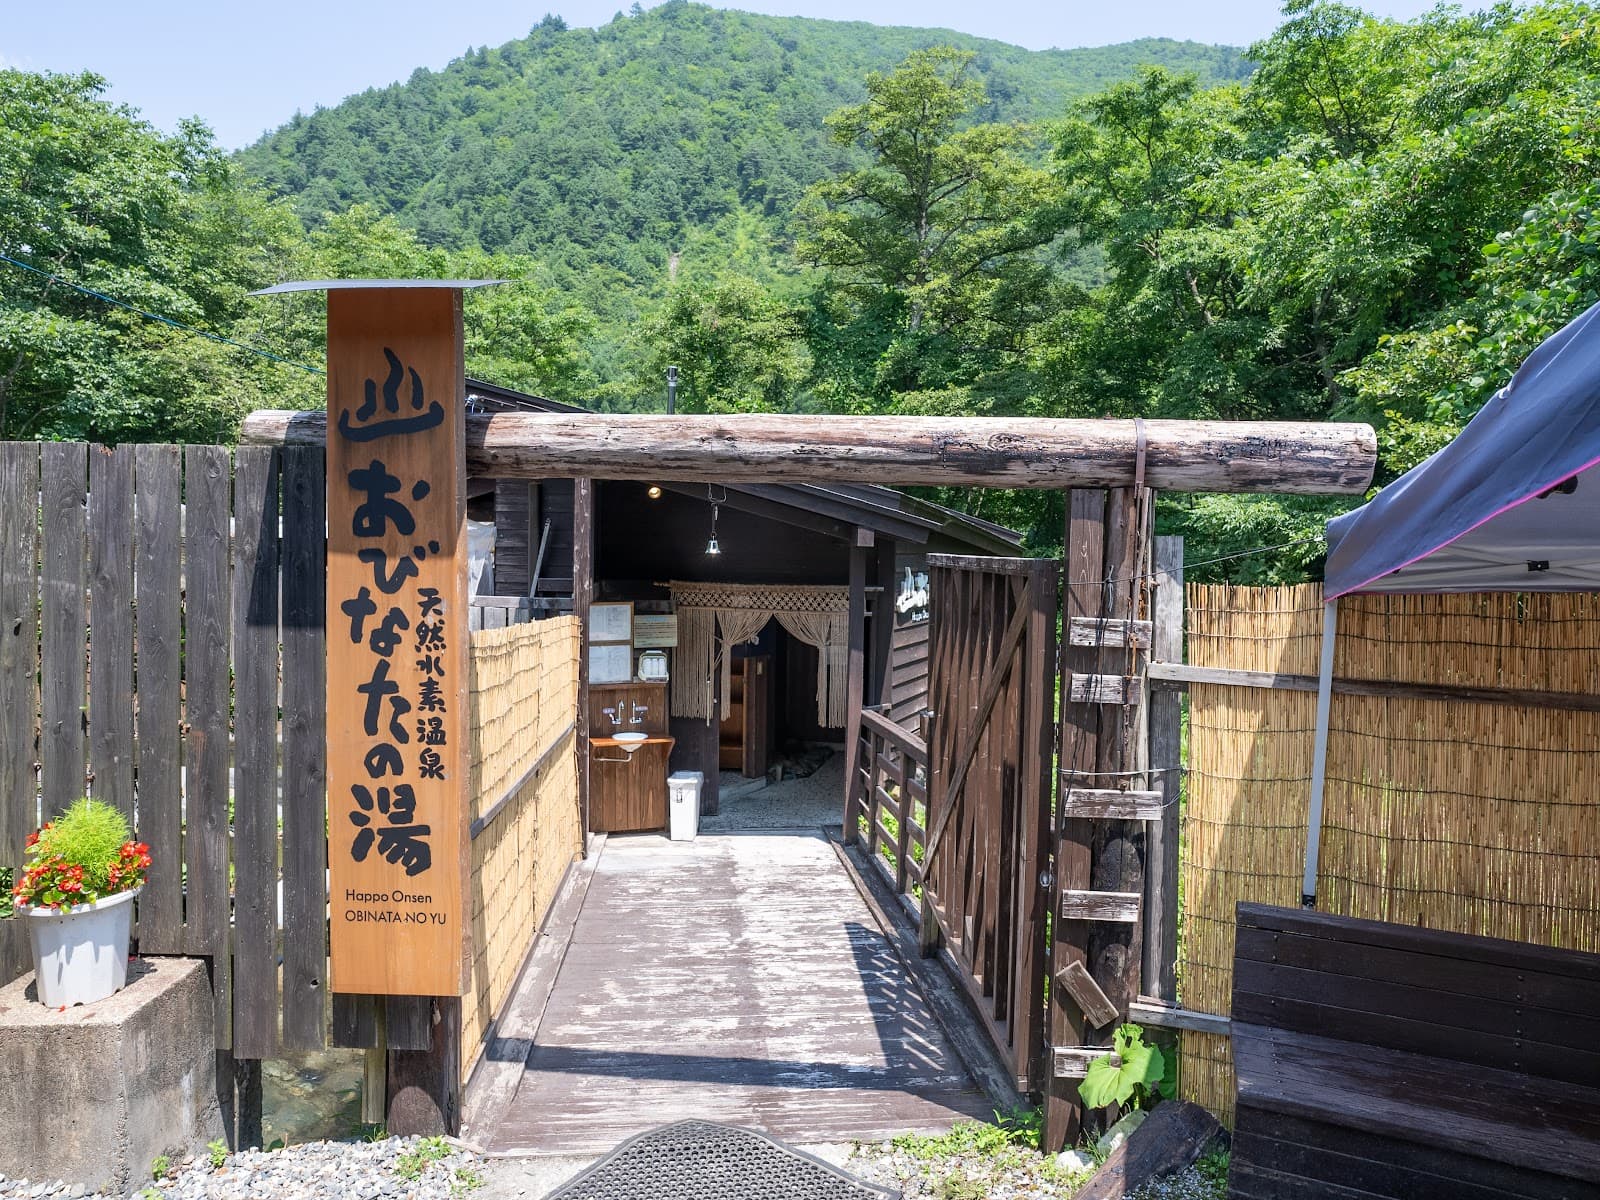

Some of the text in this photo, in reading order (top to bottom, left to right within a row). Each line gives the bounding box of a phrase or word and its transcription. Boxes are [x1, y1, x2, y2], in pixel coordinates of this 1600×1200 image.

[341, 459, 440, 877] おびなたの湯
[414, 588, 447, 780] 天然水素温泉
[345, 889, 432, 903] Happo Onsen
[345, 910, 447, 925] OBINATA NO YU
